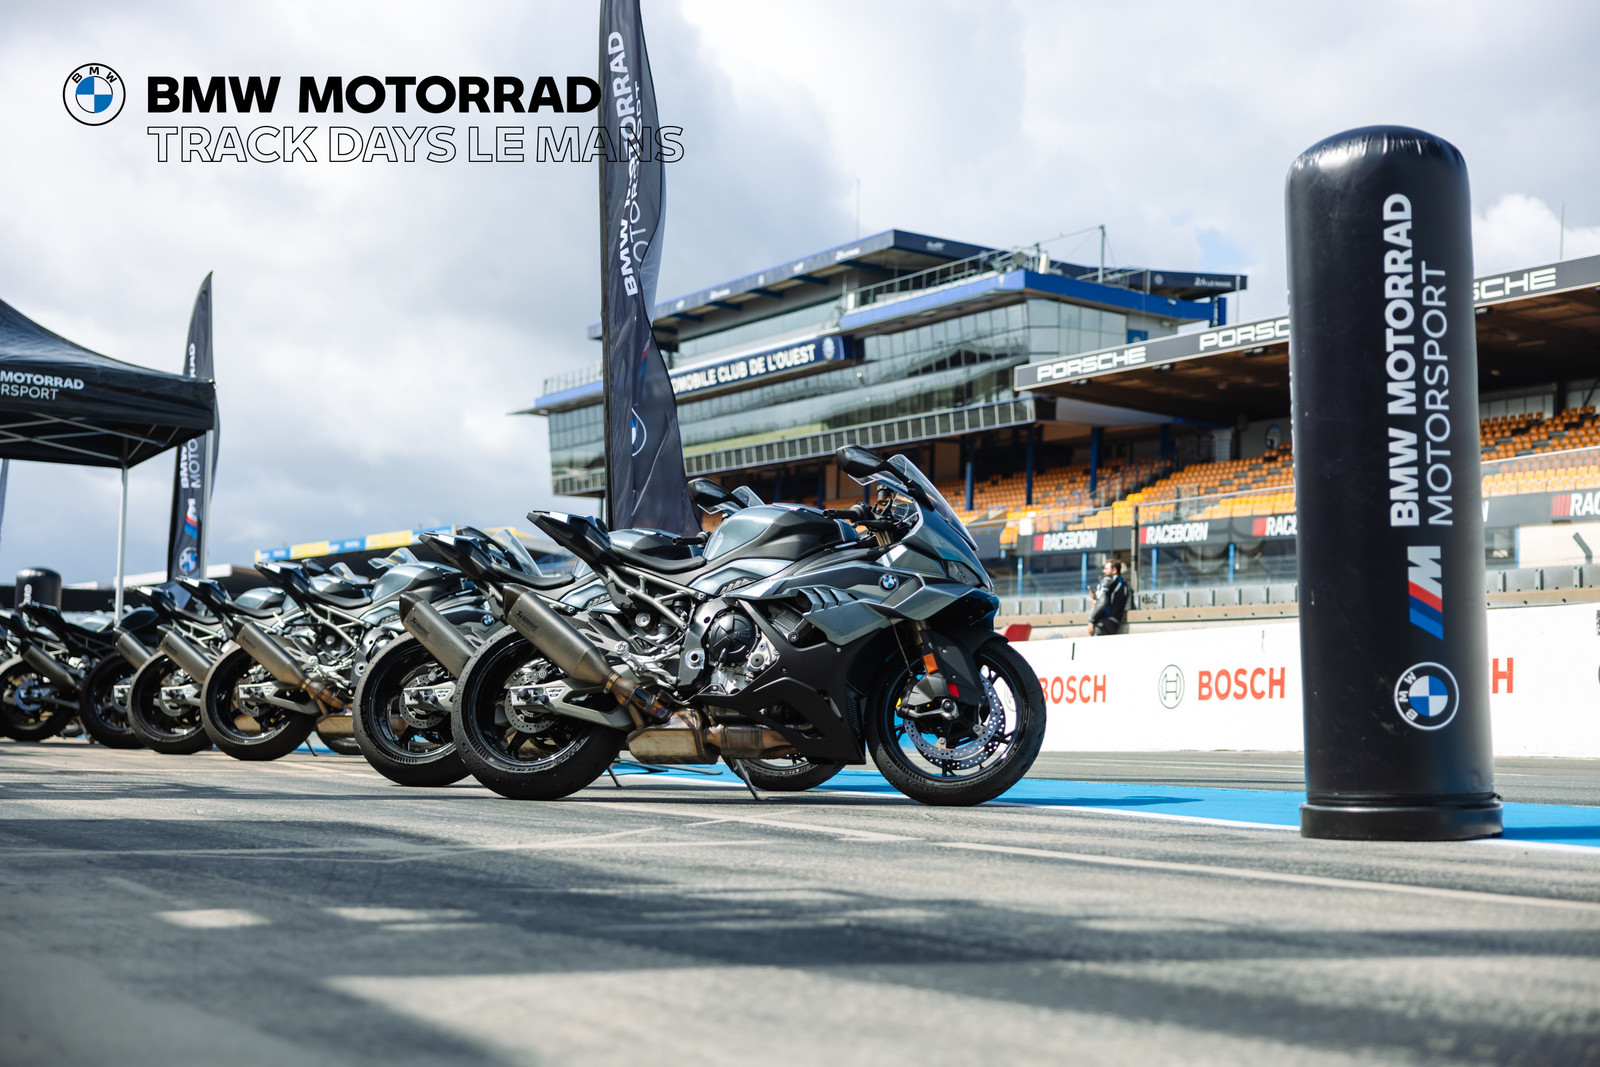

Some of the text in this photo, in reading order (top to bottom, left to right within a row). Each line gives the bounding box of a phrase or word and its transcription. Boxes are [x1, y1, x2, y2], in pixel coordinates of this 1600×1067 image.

[608, 31, 638, 296] BMW ORRAD
[718, 361, 748, 383] CLUB
[750, 356, 766, 376] DE
[767, 343, 816, 371] L'OUEST
[1037, 346, 1146, 382] PORSCHE
[1383, 193, 1419, 527] BMW MOTORRAD
[0, 370, 84, 390] MOTORRAD
[1421, 260, 1453, 526] MOTORSPORT
[1042, 530, 1098, 551] RACEBORN
[1146, 522, 1209, 544] RACEBORN
[1198, 667, 1286, 701] BOSCH
